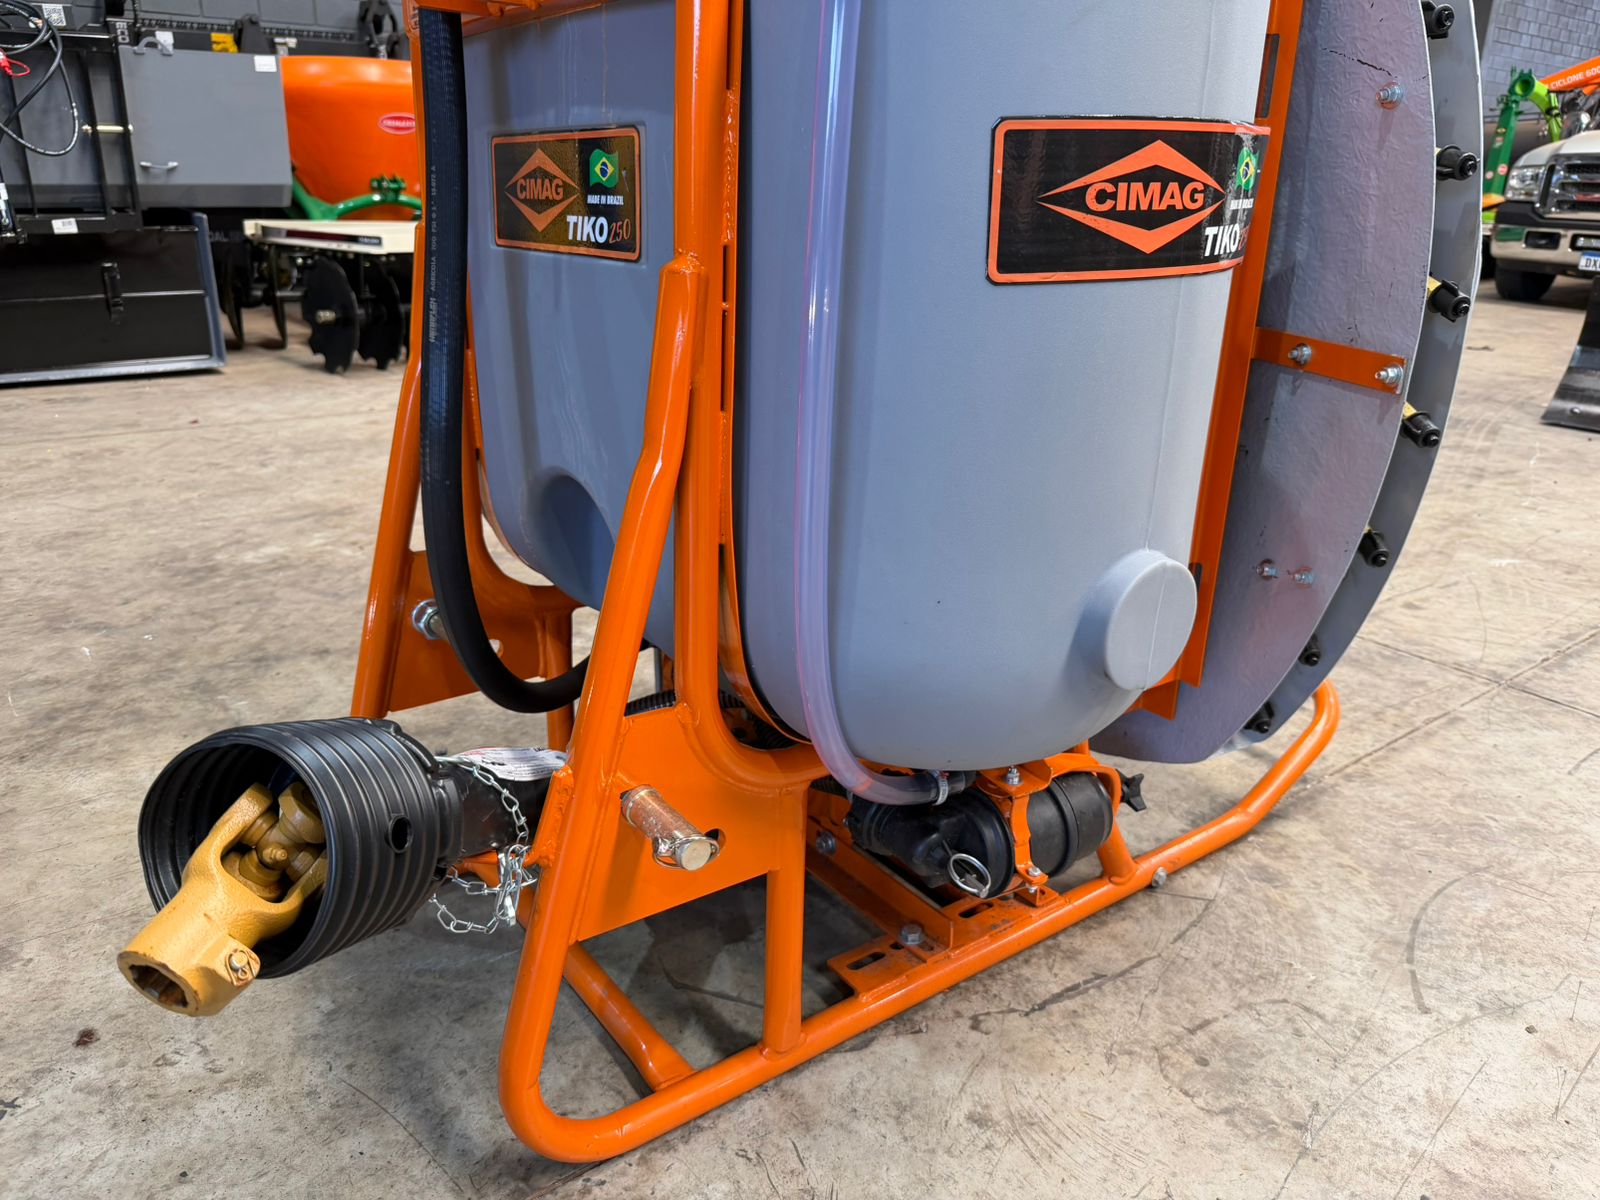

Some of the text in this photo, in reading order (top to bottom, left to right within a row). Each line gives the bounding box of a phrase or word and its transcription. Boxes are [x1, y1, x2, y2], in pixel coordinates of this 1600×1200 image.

[116, 22, 130, 43] ECO
[1551, 71, 1584, 89] CICLONE
[516, 178, 564, 200] CIMAG
[1085, 181, 1205, 212] CIMAG
[607, 195, 624, 205] BRAZIL
[566, 215, 631, 243] TIKO 250
[1204, 223, 1240, 256] TIKO
[1585, 258, 1600, 269] DX
